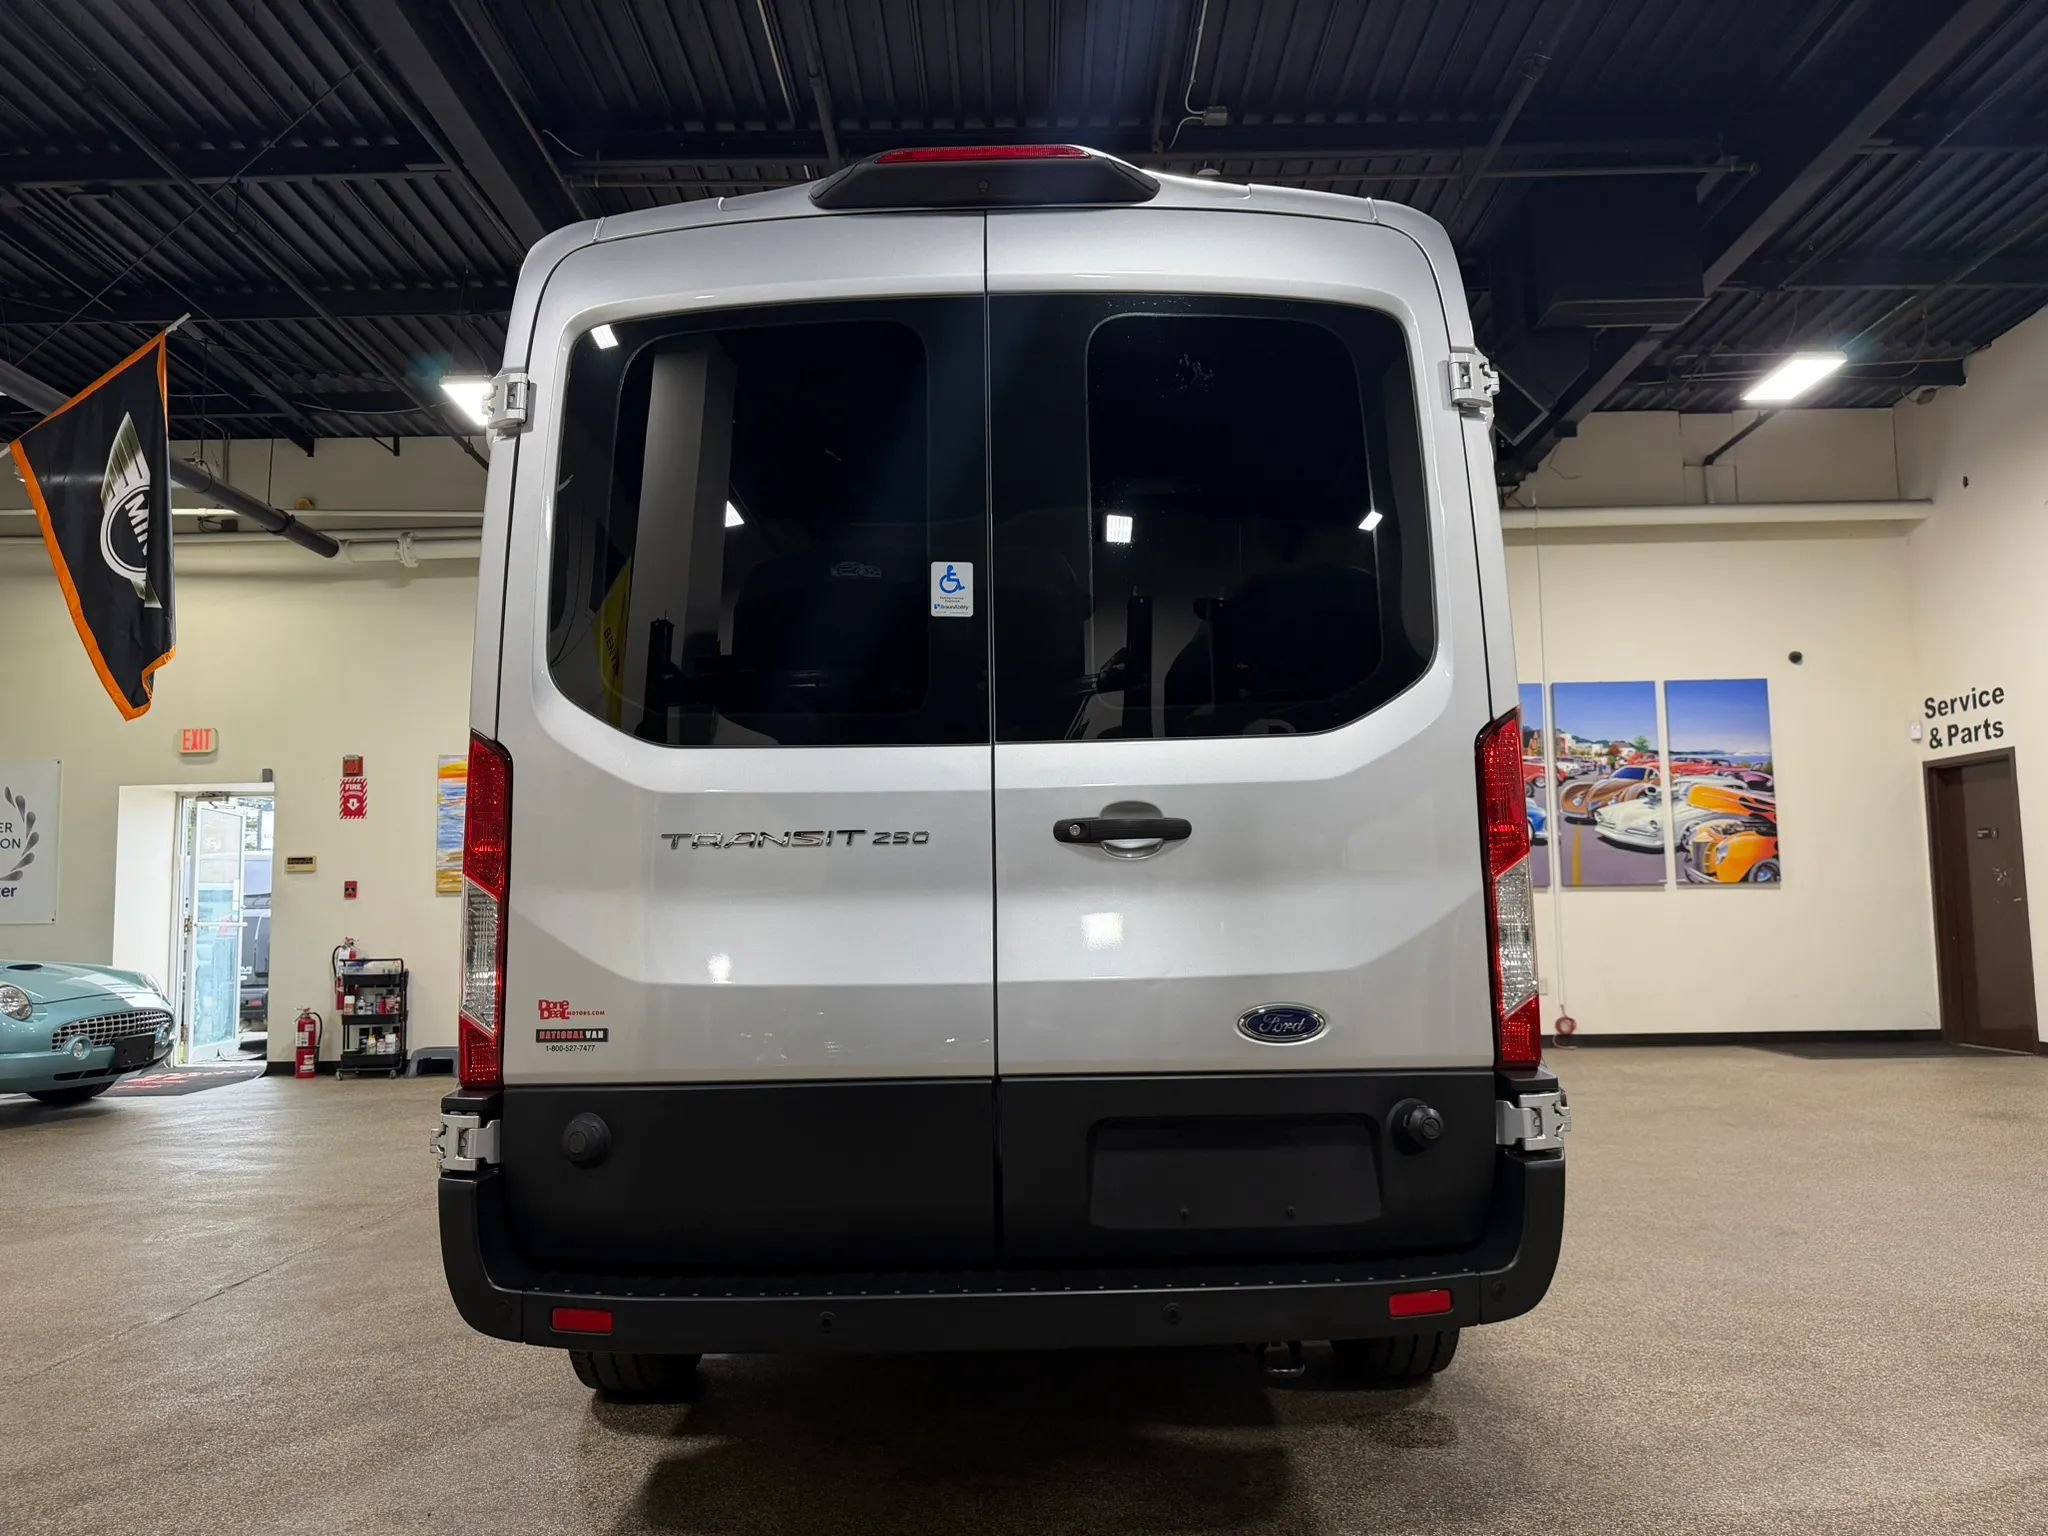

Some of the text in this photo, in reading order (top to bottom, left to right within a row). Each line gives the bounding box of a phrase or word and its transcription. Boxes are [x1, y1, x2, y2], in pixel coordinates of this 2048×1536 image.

[1924, 687, 2005, 719] Service
[183, 728, 212, 750] EXIT
[1929, 718, 2004, 749] & Parts
[345, 783, 362, 791] FIRE
[661, 830, 930, 849] TRANSIT 250
[1259, 1013, 1306, 1033] Ford
[539, 1030, 604, 1040] NATIONAL VAN
[545, 1044, 596, 1052] 1-800-527-7477
